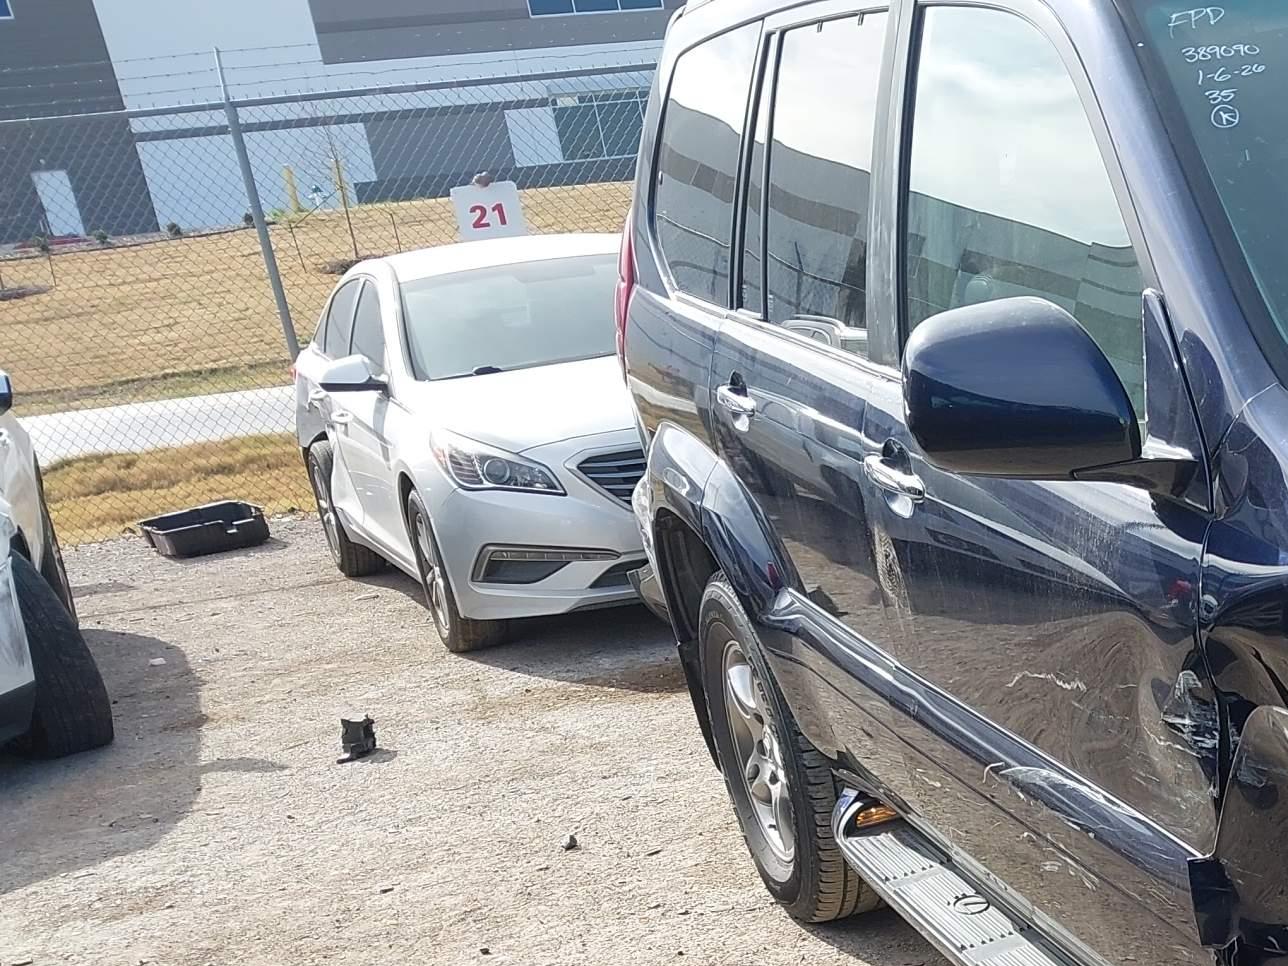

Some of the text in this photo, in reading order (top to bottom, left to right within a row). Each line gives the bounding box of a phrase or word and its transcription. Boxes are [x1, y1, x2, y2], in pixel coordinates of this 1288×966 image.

[1182, 44, 1260, 62] 389090
[1198, 63, 1265, 85] 1-6-26
[1205, 89, 1238, 104] 35
[469, 203, 507, 229] 21
